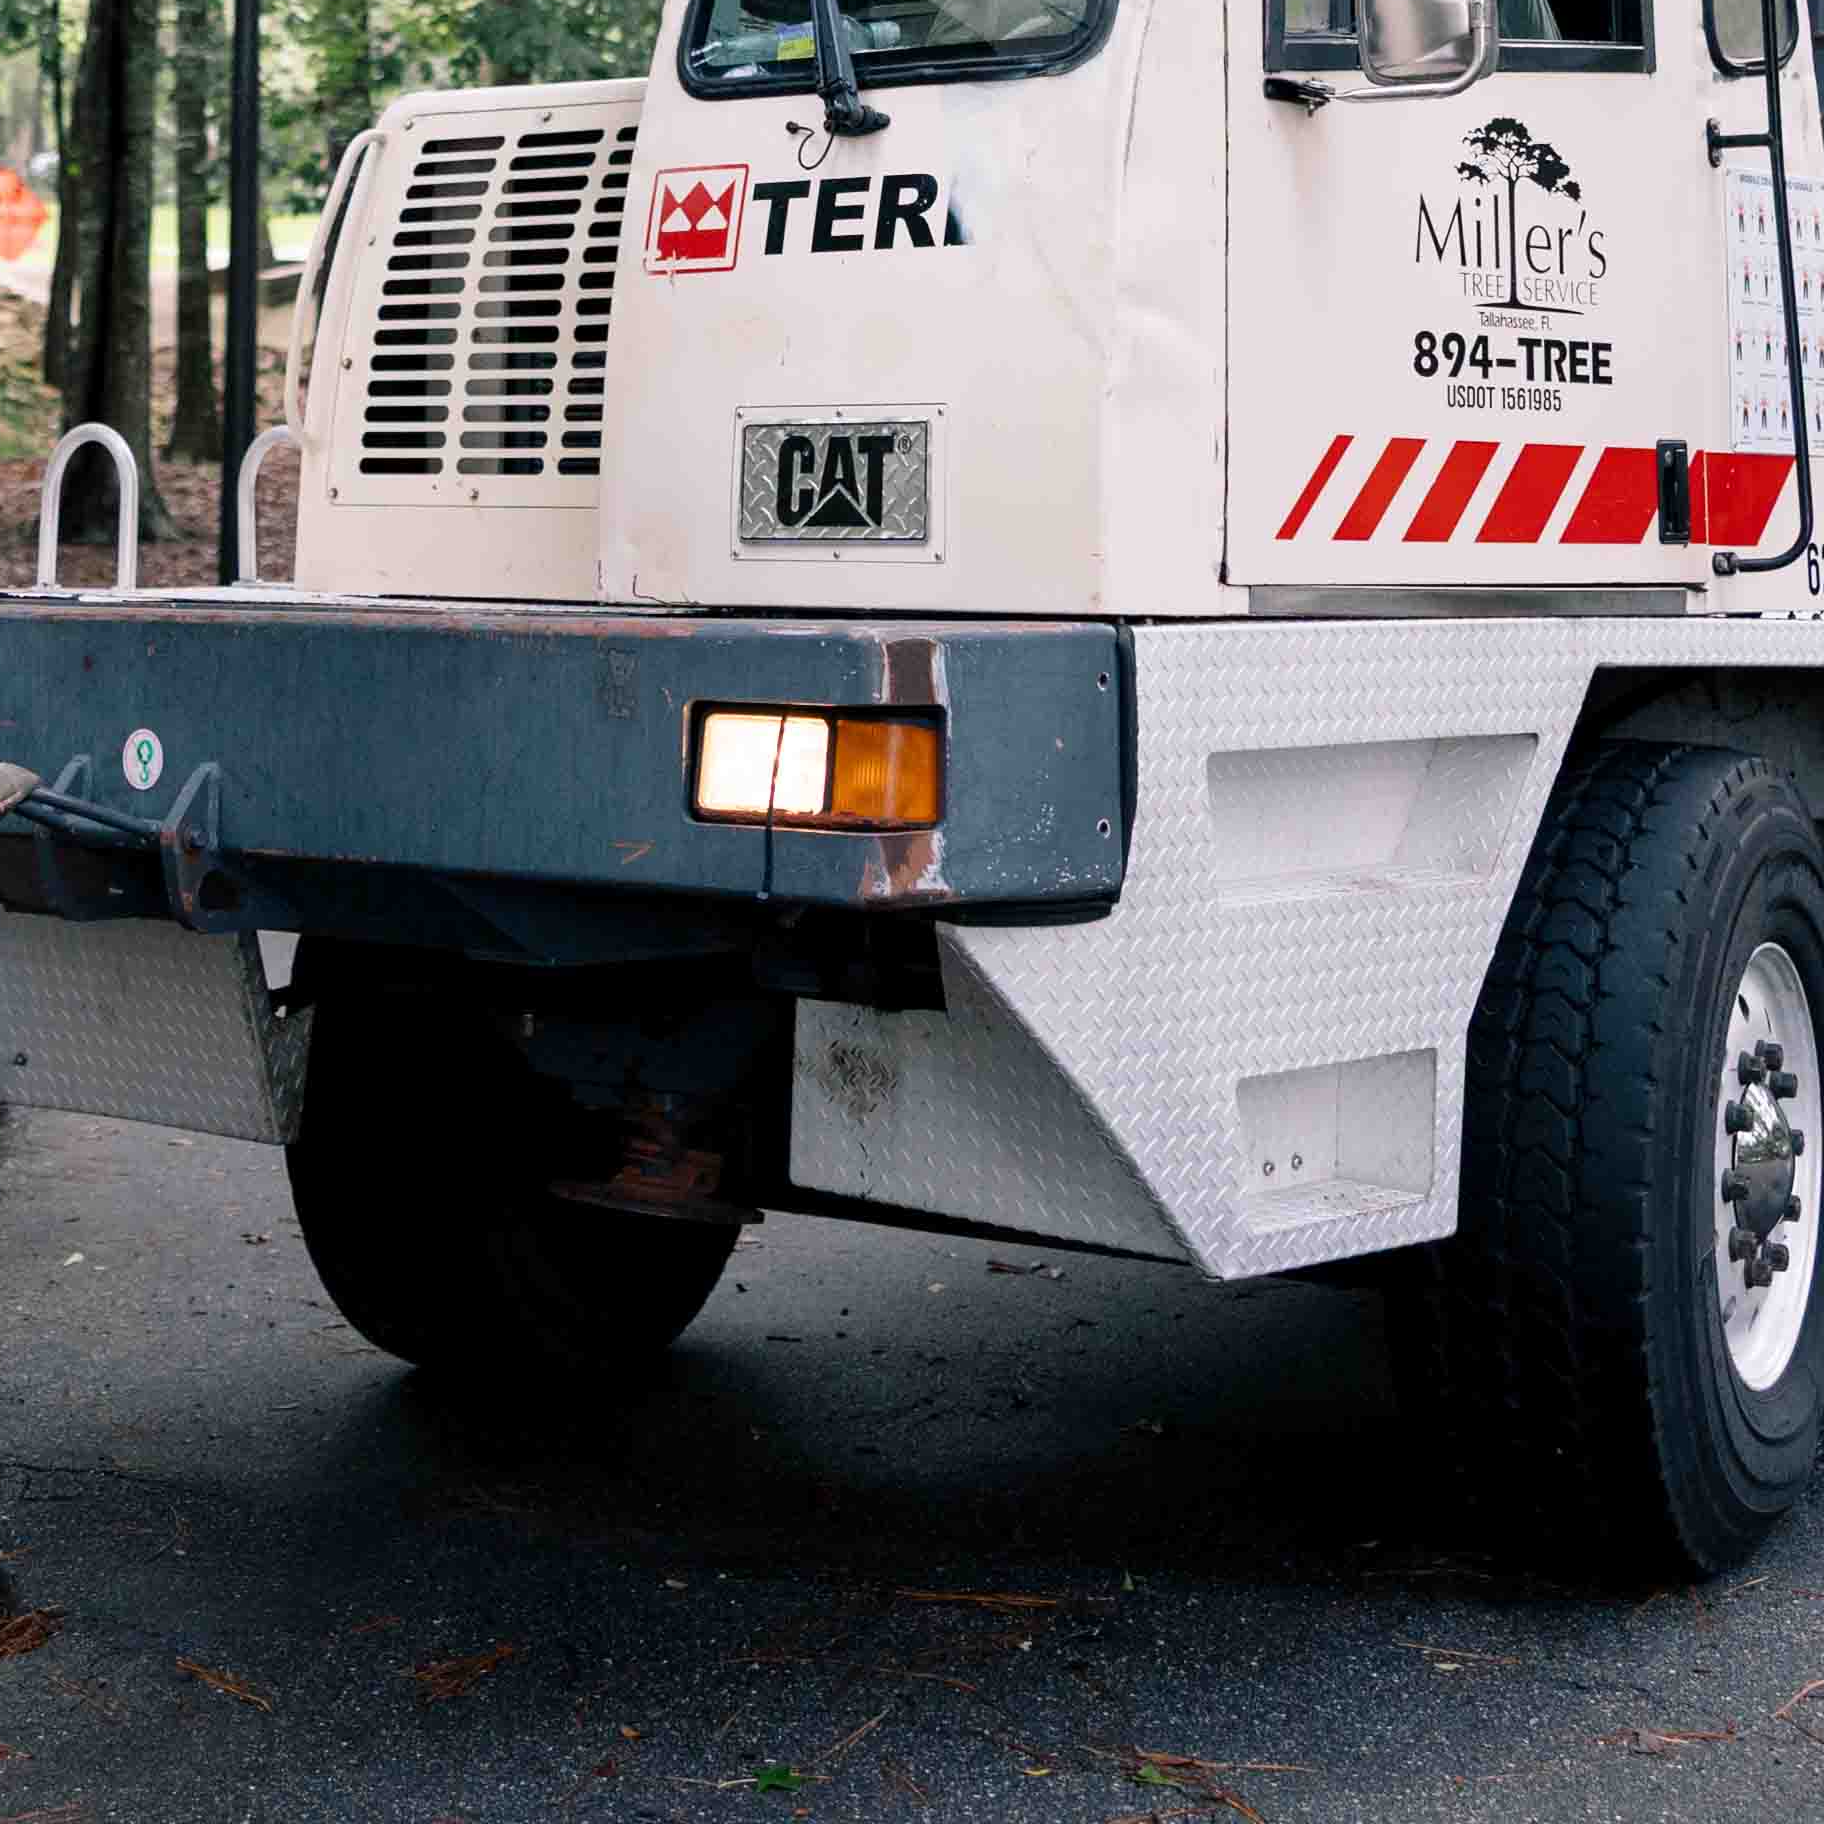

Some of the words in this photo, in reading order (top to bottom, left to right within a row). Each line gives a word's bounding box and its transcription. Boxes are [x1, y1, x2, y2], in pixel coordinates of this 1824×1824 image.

[752, 172, 974, 256] TER
[1416, 193, 1607, 279] Miller's
[1460, 272, 1504, 298] TREE
[1522, 277, 1599, 306] SERVICE
[1479, 312, 1538, 331] Tallahassee,
[1413, 330, 1614, 386] 894-TREE
[1447, 385, 1496, 409] USDOT
[1501, 388, 1562, 412] 1561985
